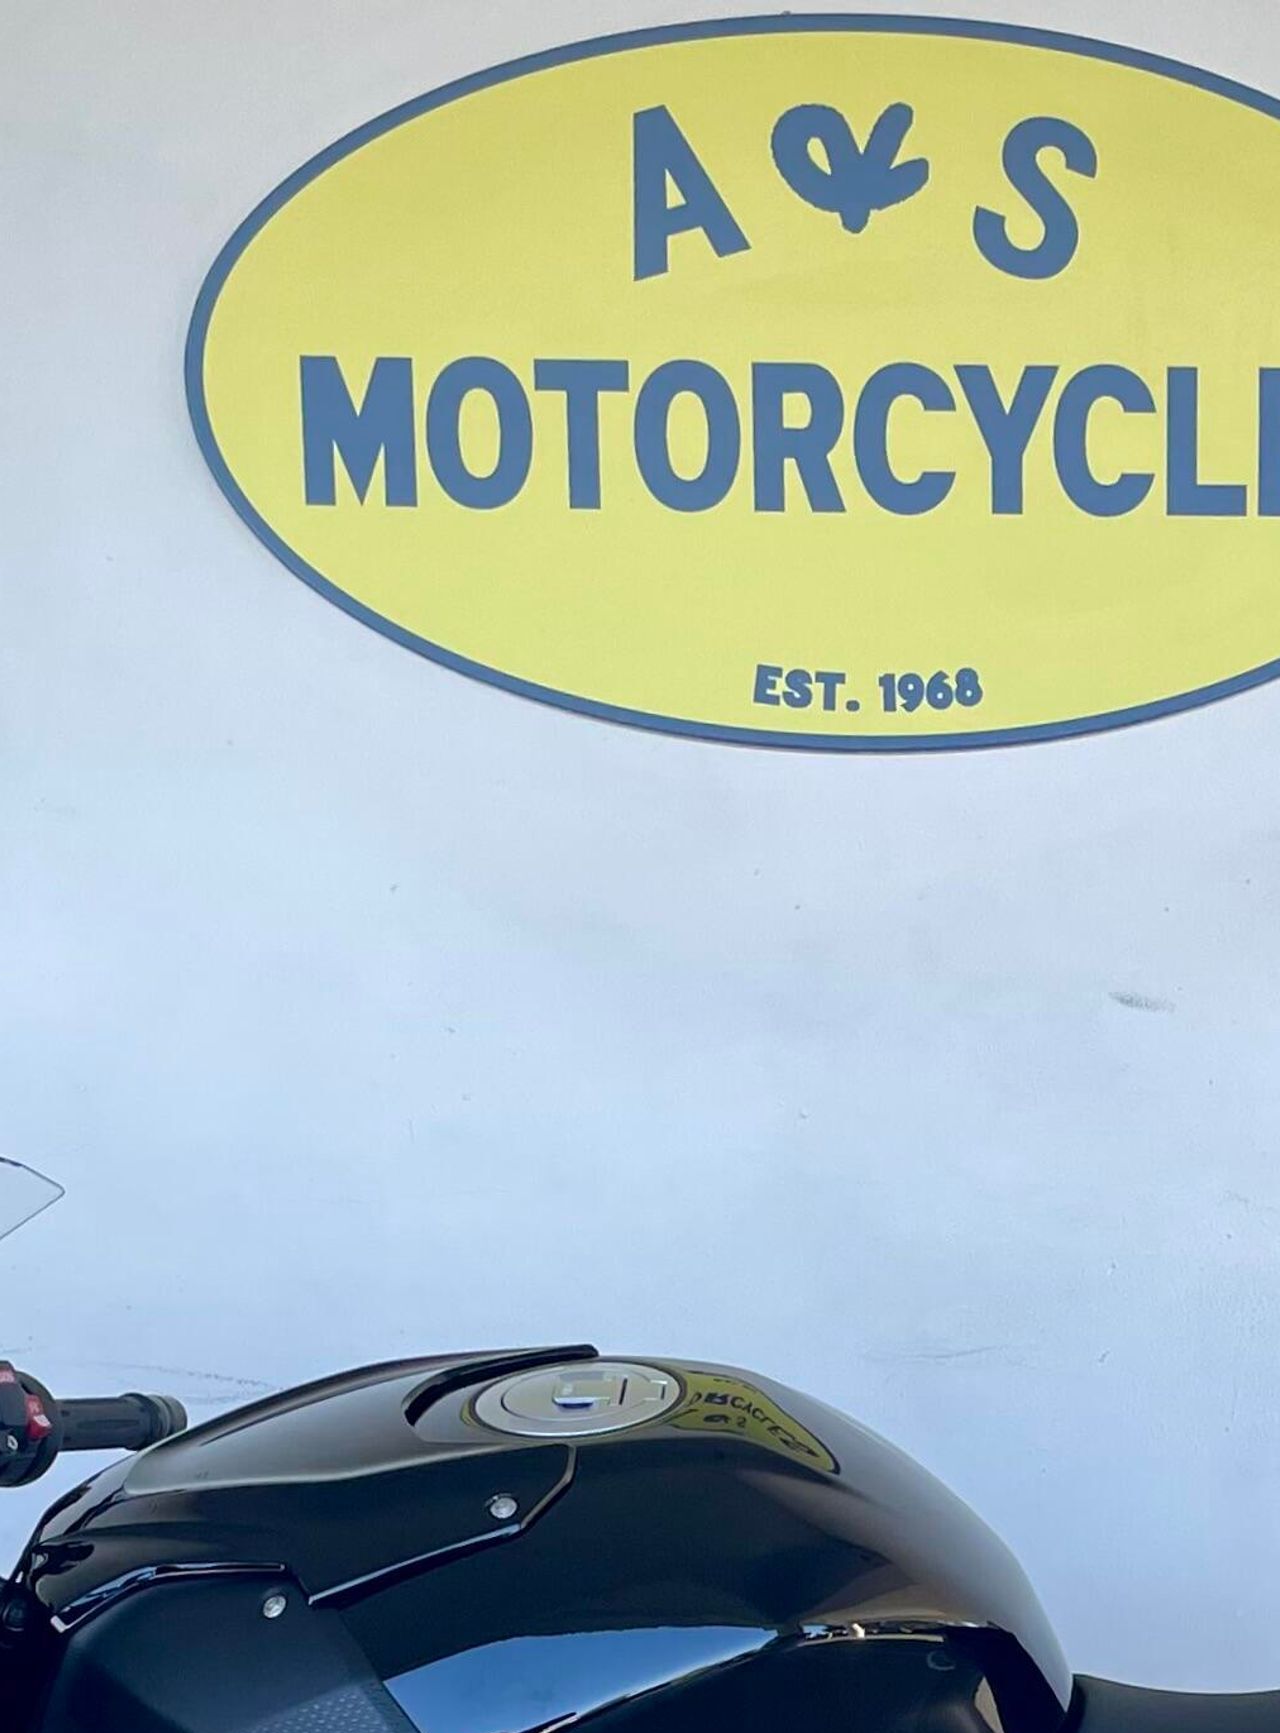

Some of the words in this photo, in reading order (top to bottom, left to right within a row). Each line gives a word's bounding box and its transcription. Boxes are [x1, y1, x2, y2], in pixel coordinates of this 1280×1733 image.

[633, 104, 752, 282] A
[973, 115, 1098, 280] S
[753, 664, 860, 712] EST.
[878, 667, 983, 713] 1968
